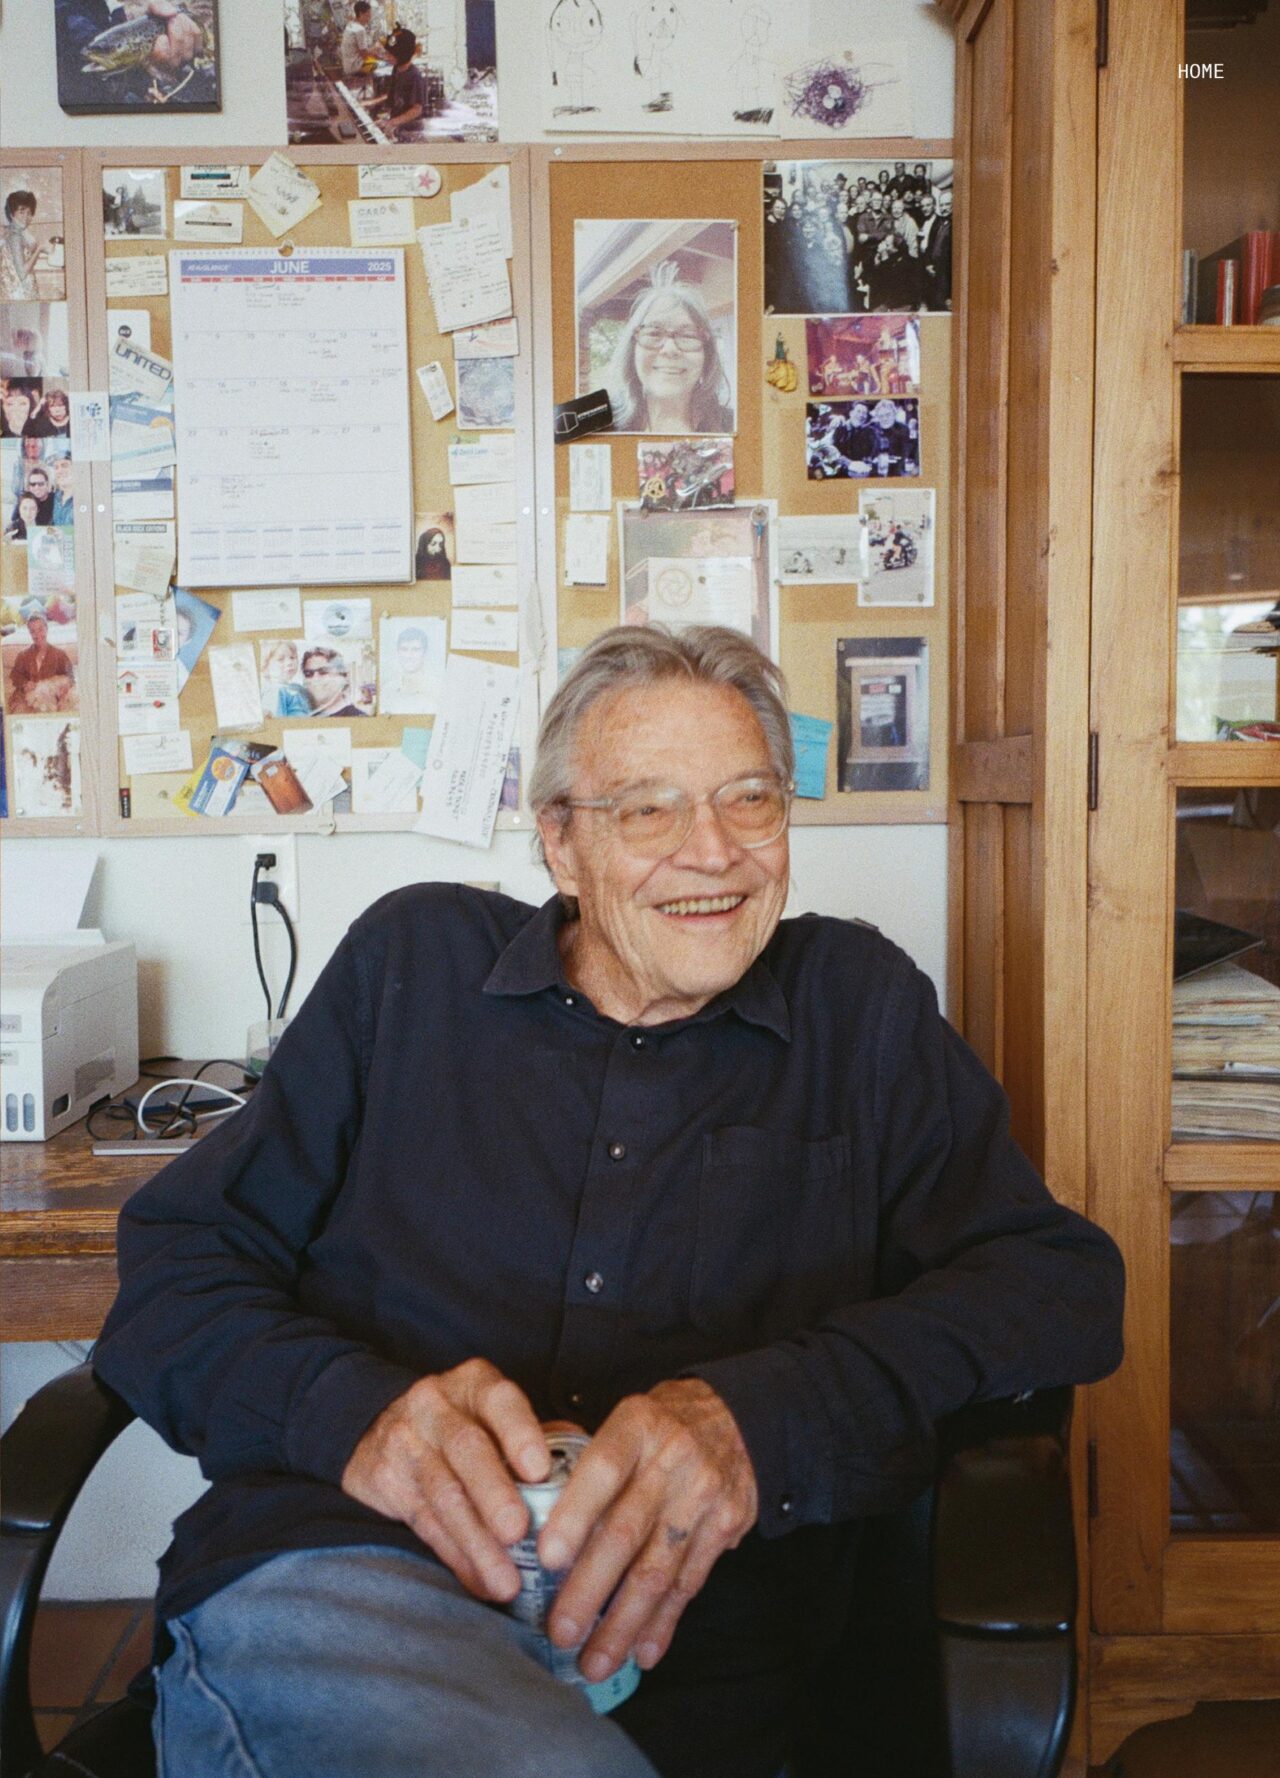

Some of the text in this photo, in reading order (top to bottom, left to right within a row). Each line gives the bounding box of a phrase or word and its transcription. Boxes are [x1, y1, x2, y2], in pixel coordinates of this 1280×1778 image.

[270, 261, 311, 274] JUNE
[367, 262, 392, 272] 2025
[115, 343, 172, 382] UNITED
